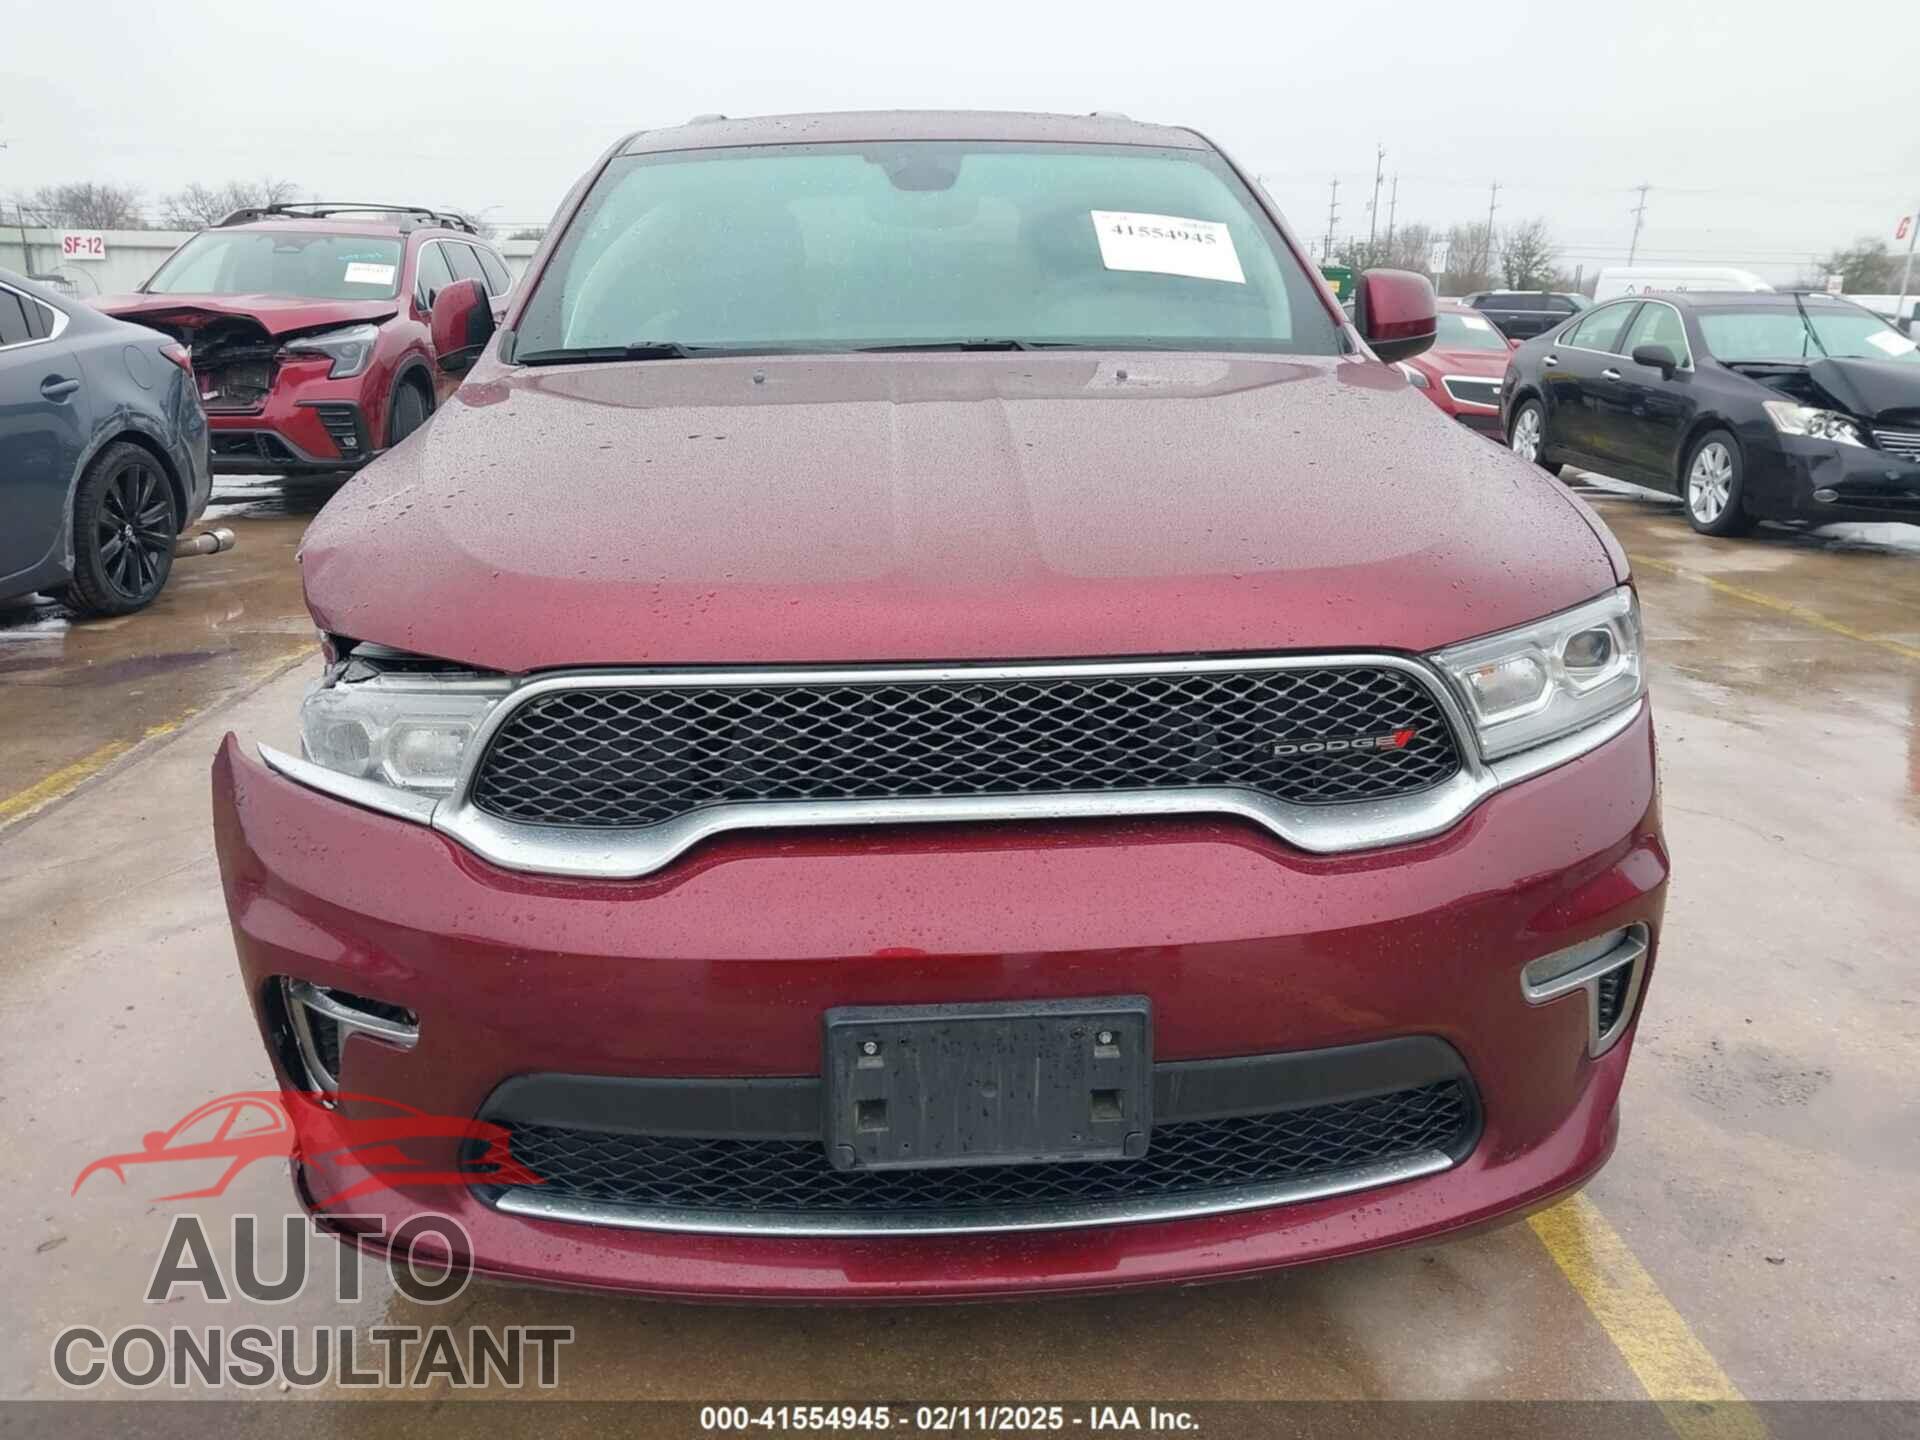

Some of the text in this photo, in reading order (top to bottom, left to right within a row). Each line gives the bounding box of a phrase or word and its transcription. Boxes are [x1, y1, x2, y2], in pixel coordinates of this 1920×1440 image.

[1111, 223, 1217, 245] 41554945
[64, 236, 102, 254] SF-12
[1273, 734, 1399, 755] DODGE
